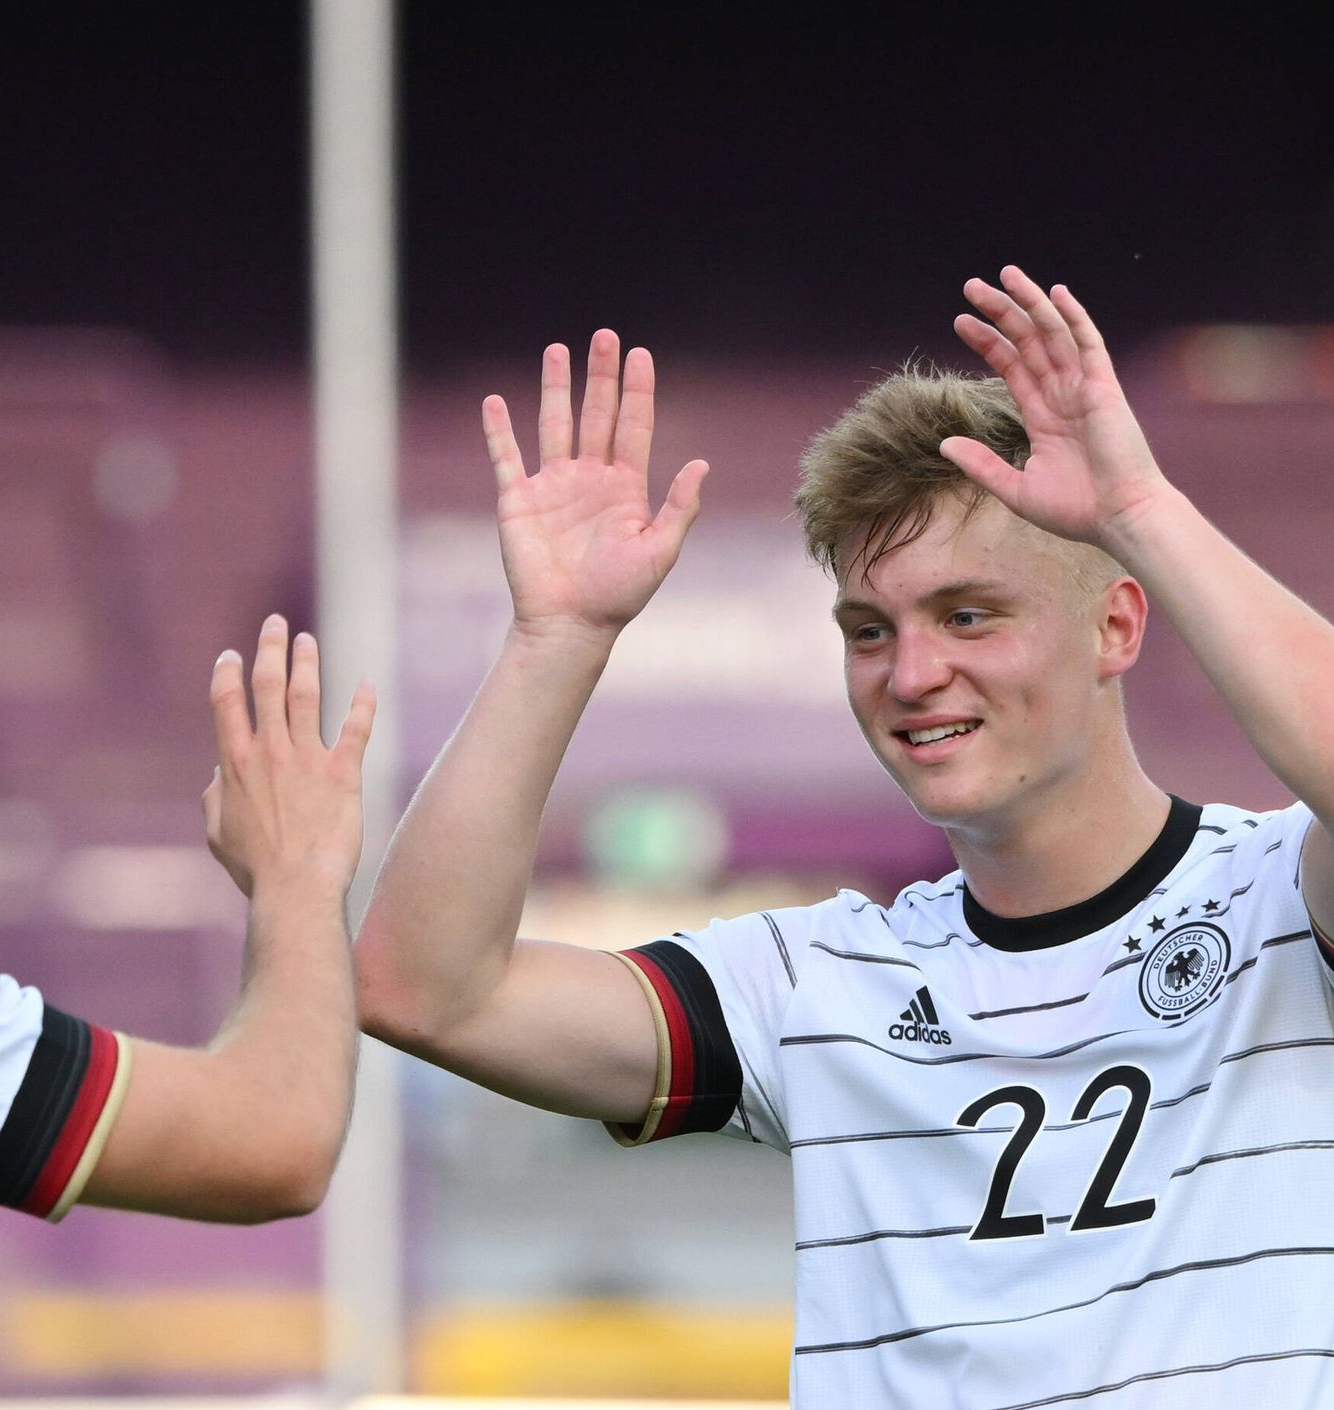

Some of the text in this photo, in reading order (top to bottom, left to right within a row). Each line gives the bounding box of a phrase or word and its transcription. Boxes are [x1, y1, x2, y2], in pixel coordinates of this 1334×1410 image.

[1153, 933, 1204, 970] DEUTSCHER
[888, 1020, 952, 1045] adidas
[956, 1064, 1157, 1241] 22
